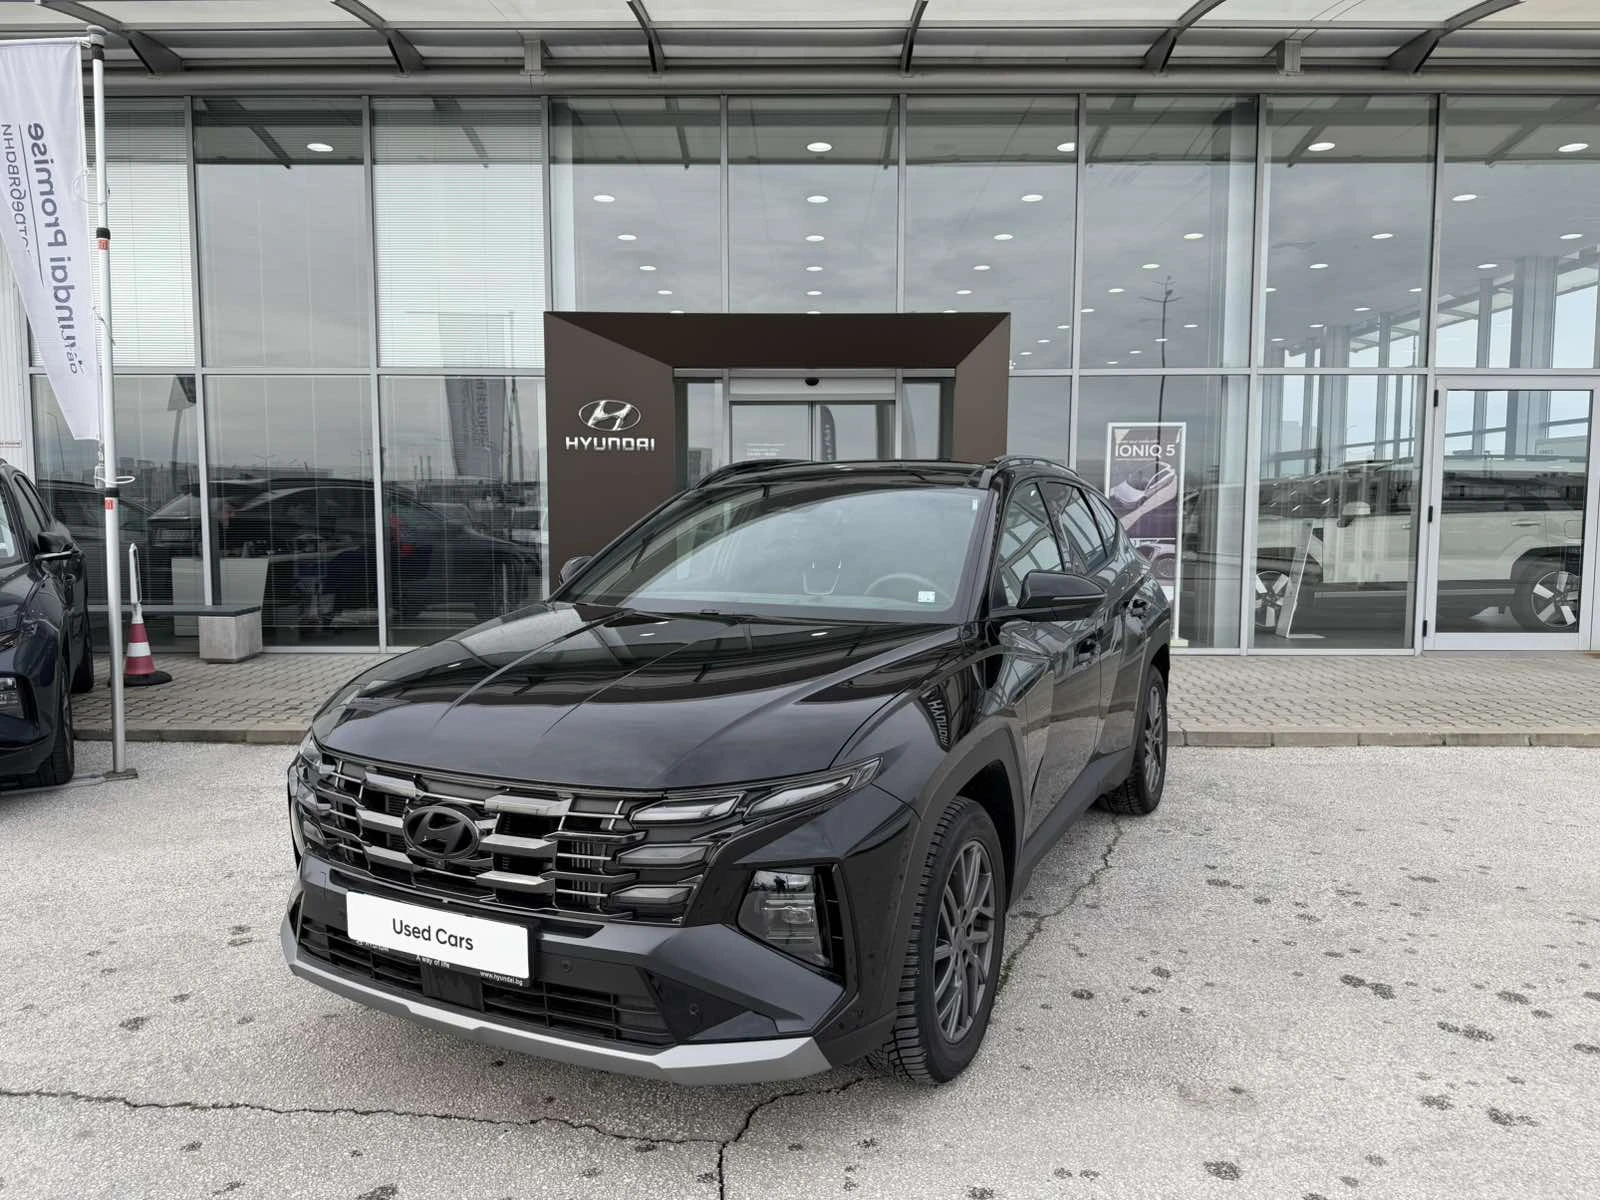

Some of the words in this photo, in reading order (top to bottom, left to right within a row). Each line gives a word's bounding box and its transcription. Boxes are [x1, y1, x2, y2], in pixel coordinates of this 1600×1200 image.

[565, 436, 656, 451] HYUNDAI
[1115, 444, 1163, 458] IONIQ
[1165, 444, 1176, 457] 5
[480, 971, 523, 987] www.hyundai.bg
